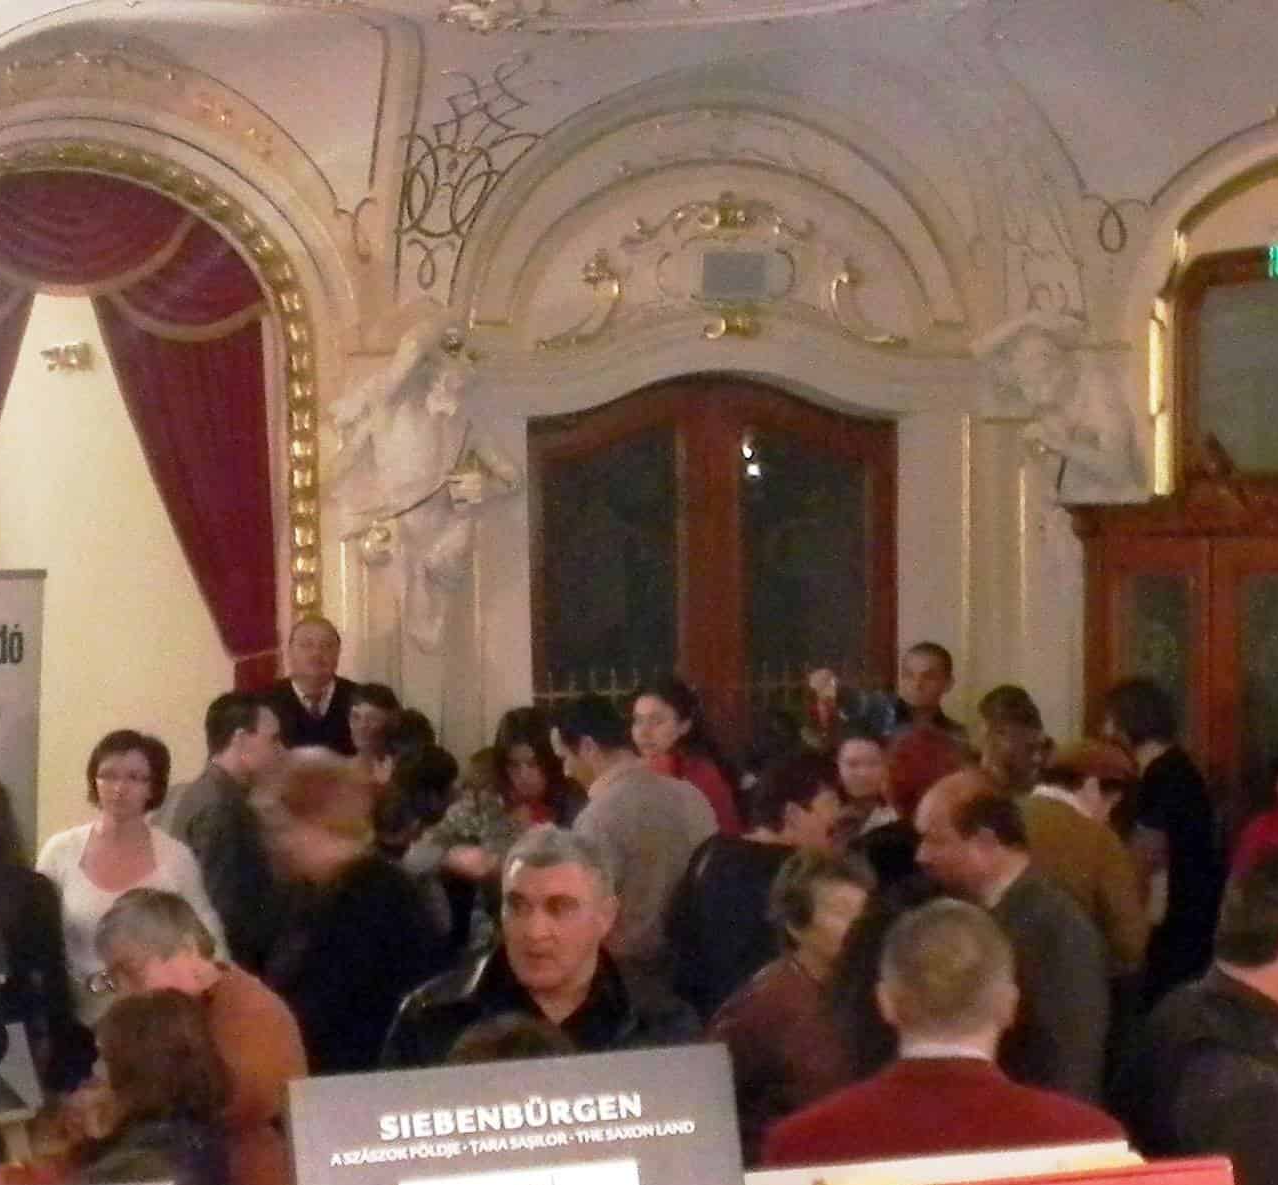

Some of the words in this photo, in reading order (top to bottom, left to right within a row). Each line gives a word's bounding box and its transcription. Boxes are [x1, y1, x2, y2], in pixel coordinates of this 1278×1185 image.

[380, 1092, 642, 1141] SIEBENBÜRGEN
[576, 1127, 601, 1143] THE
[602, 1123, 653, 1141] SAXON
[655, 1119, 696, 1137] LAND
